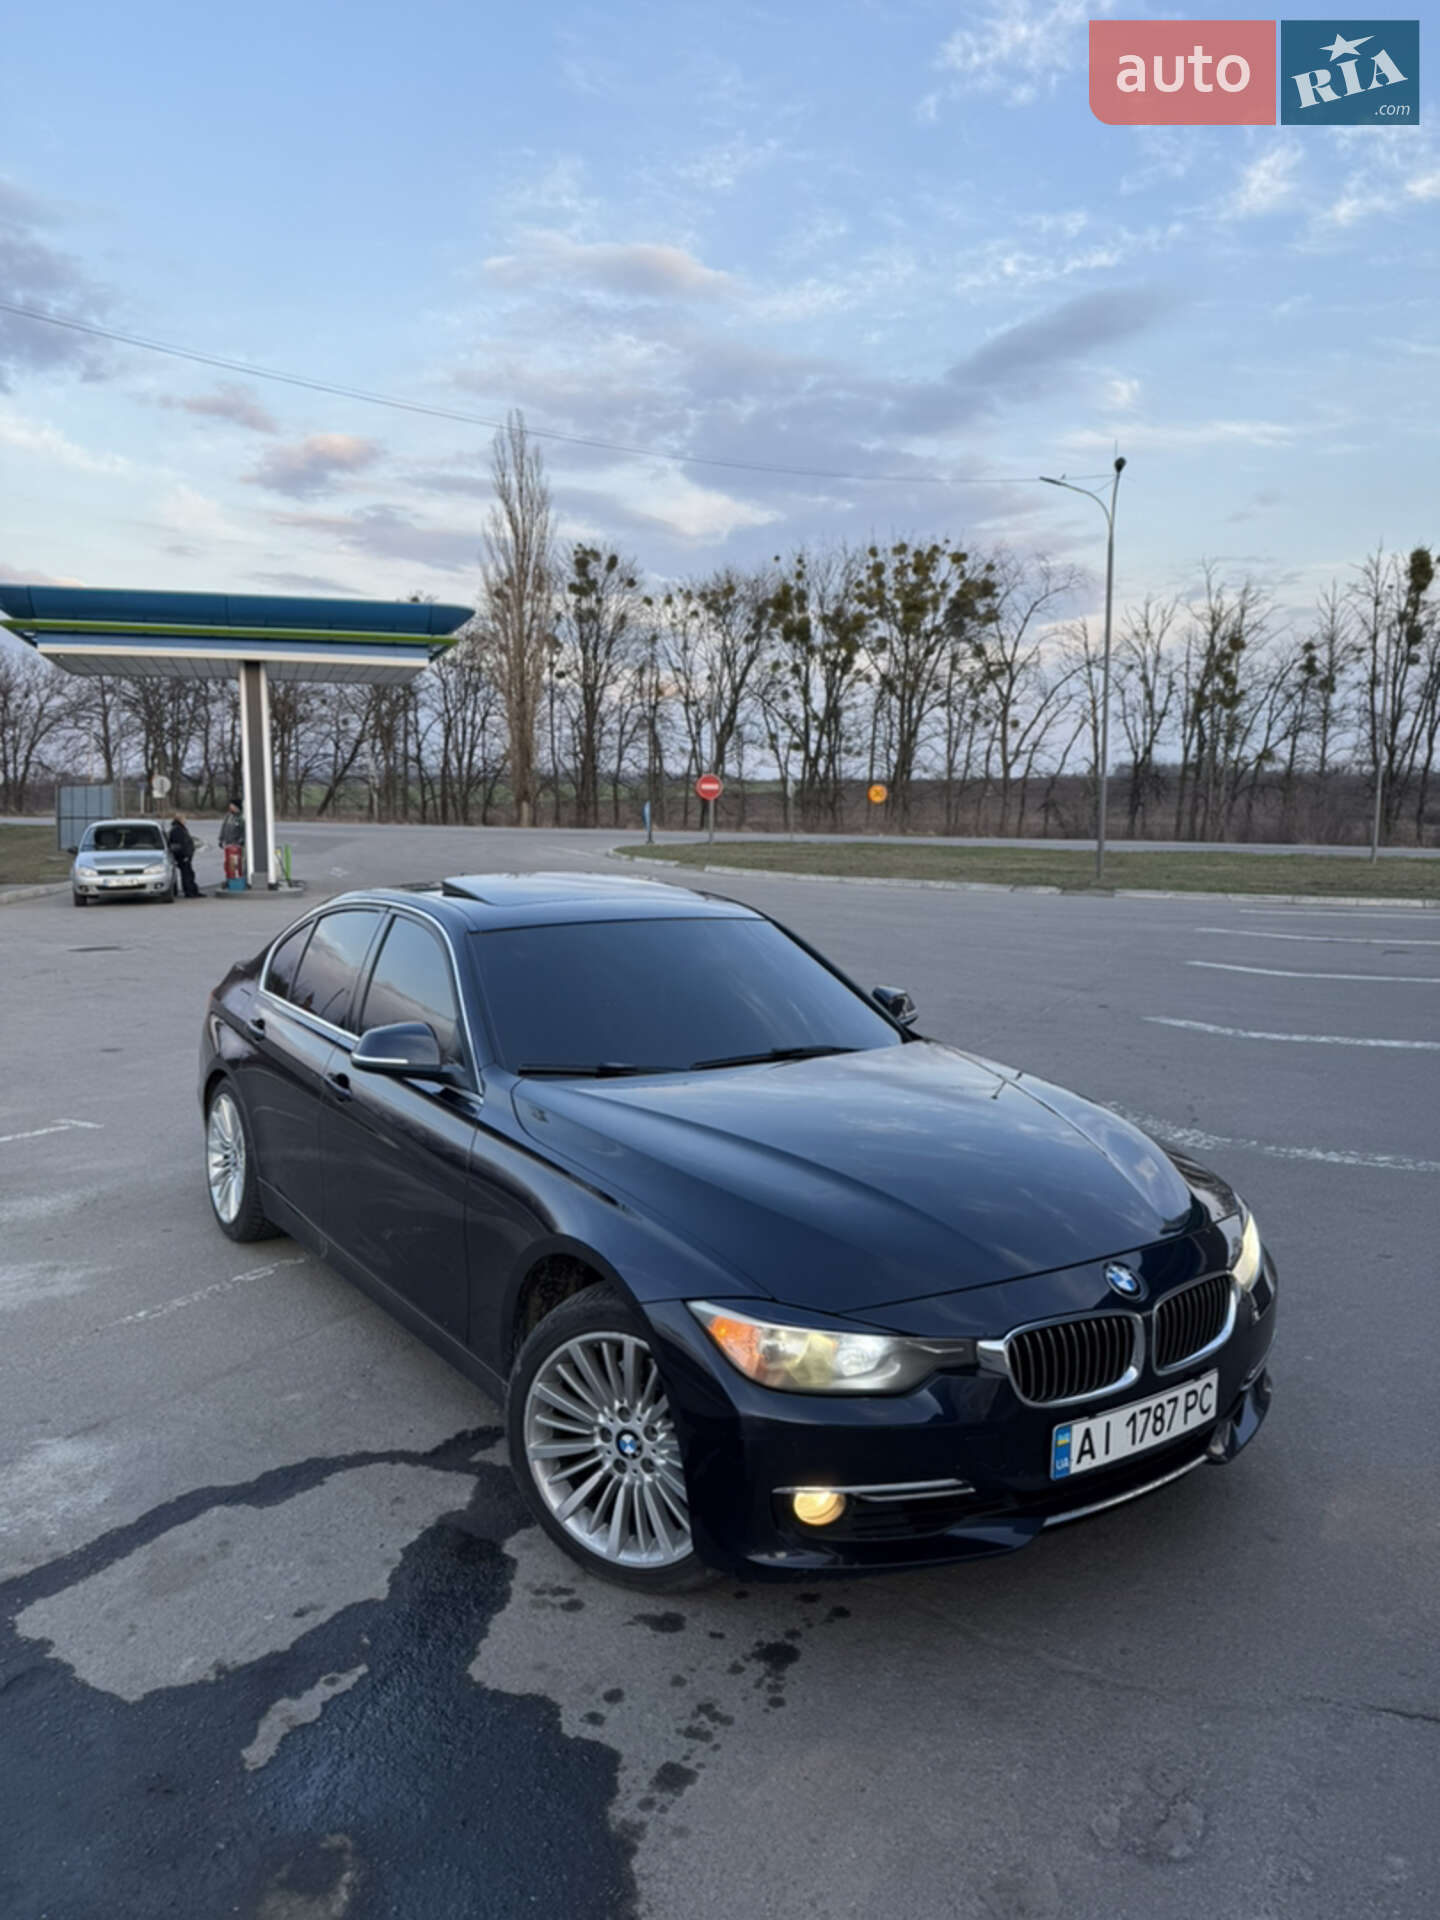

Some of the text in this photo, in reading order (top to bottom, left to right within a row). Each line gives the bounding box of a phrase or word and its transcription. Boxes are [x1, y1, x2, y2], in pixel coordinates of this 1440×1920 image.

[1076, 1382, 1213, 1464] AI 1787 PC
